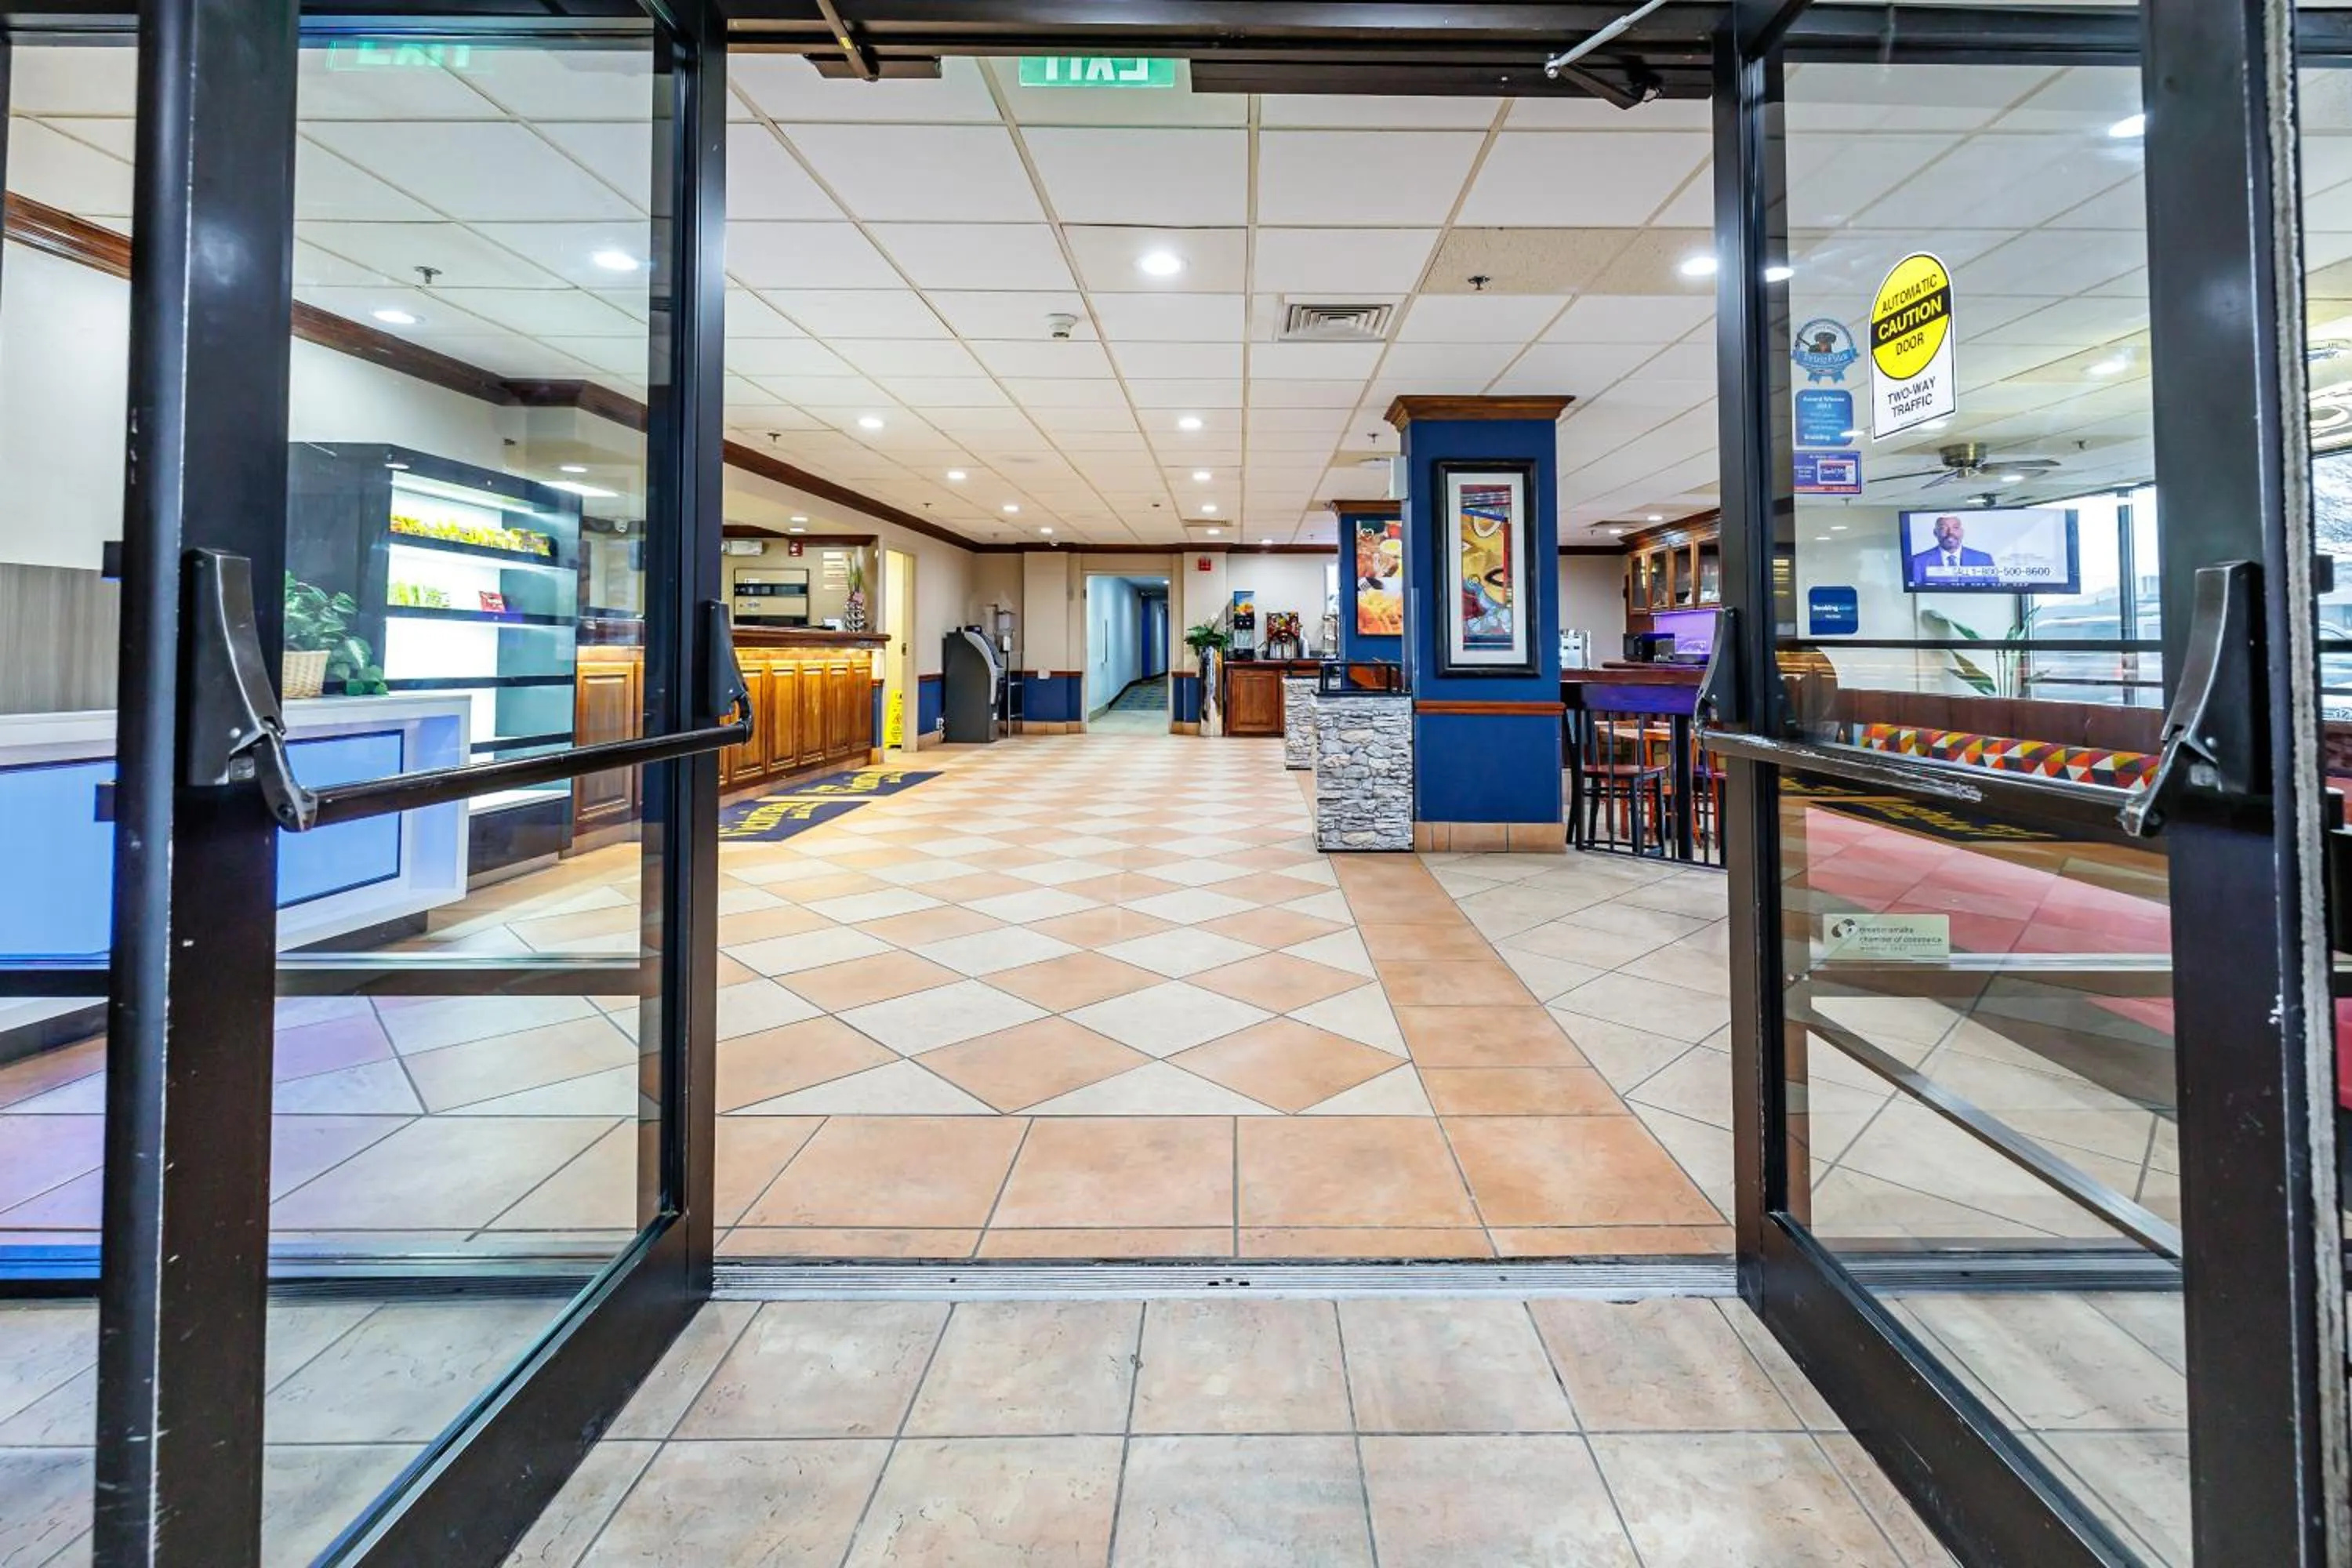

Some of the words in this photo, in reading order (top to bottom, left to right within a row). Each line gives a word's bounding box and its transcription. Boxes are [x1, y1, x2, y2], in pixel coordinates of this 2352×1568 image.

[1882, 274, 1938, 314] AUTOMATIC
[1878, 295, 1943, 339] CAUTION
[1896, 332, 1926, 355] DOOR
[1888, 376, 1936, 405] TWO-WAY
[1891, 393, 1933, 418] TRAFFIC
